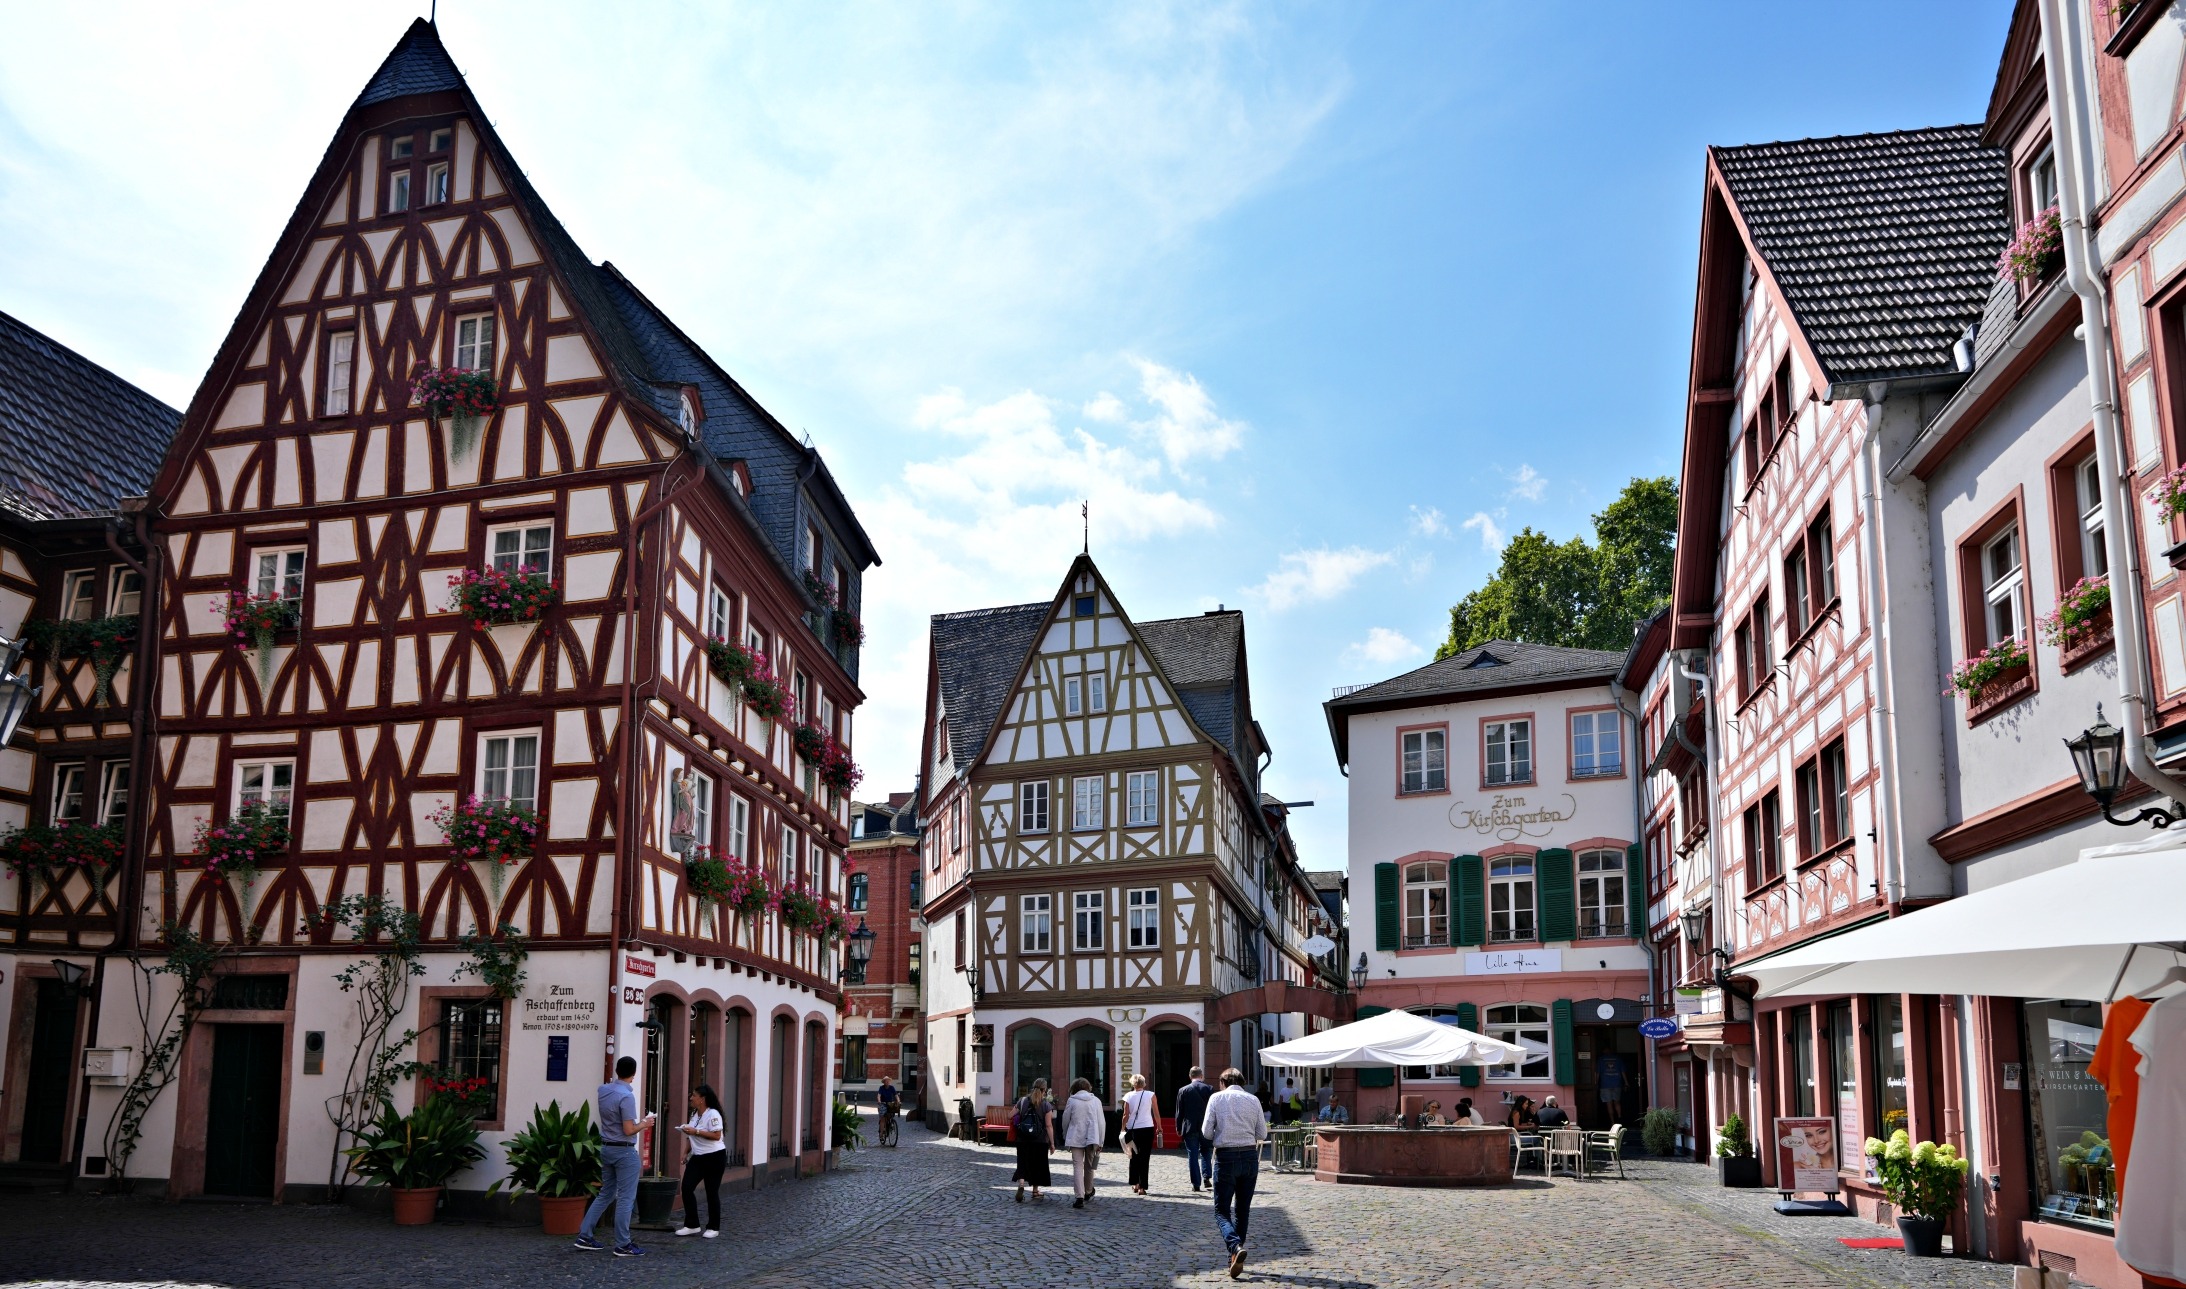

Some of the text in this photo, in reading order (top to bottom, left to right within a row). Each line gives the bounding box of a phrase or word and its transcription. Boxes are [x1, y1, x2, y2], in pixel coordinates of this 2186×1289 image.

[1491, 794, 1526, 810] Zum
[550, 984, 574, 996] Zum
[525, 999, 595, 1013] Aschaffenberg
[1118, 1030, 1133, 1105] genblick
[2049, 1070, 2070, 1080] WEIN
[2074, 1071, 2080, 1080] &
[2044, 1083, 2105, 1091] KIRSCHGARTEN
